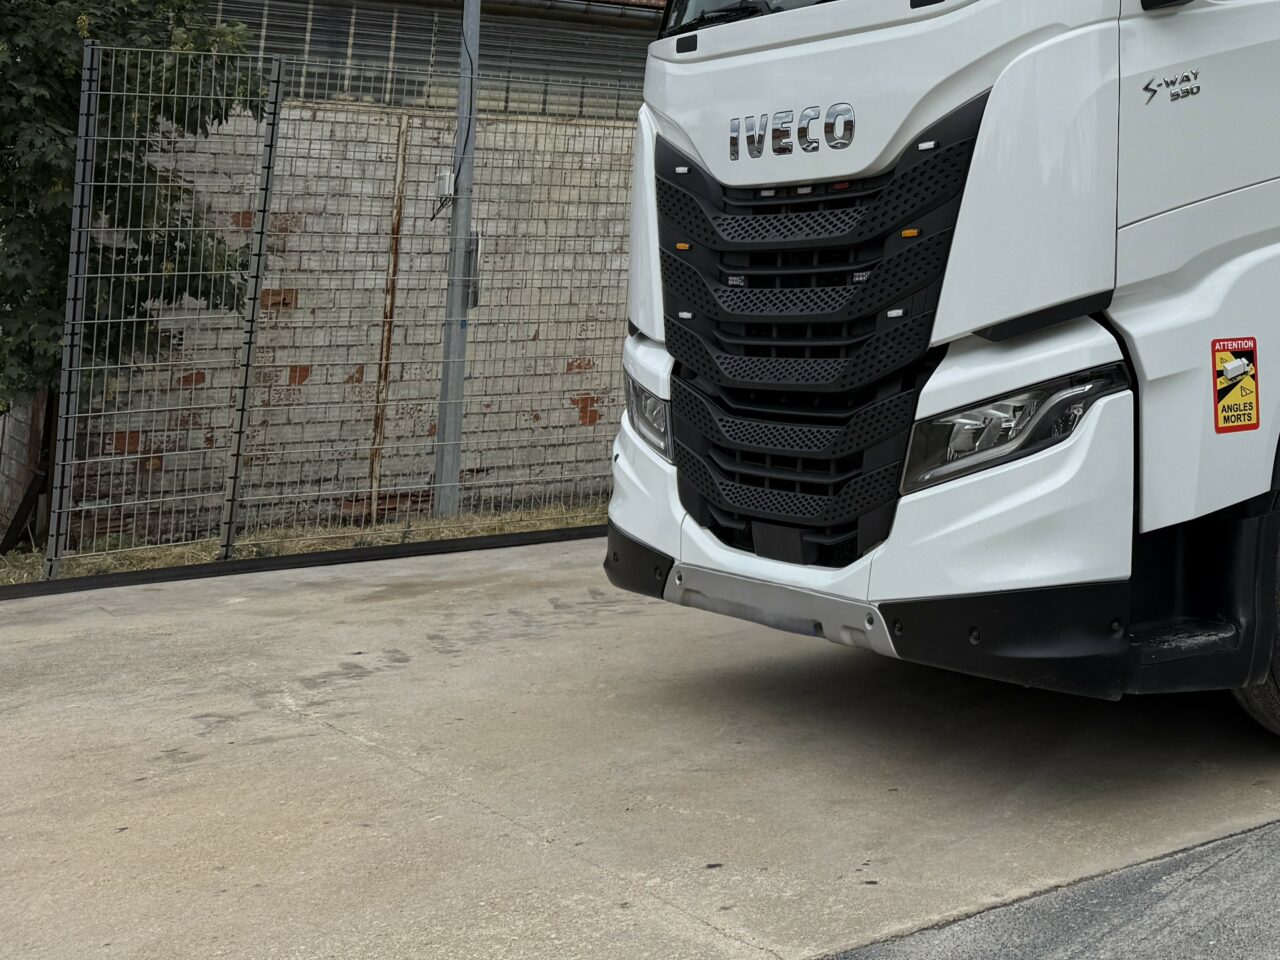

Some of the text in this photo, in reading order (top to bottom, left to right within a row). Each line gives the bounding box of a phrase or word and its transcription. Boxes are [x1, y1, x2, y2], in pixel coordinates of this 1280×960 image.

[1142, 68, 1200, 106] S-WAY
[1170, 84, 1201, 102] 530
[729, 102, 856, 162] IVECO
[1215, 340, 1254, 350] ATTENTION
[1221, 401, 1254, 414] ANGLES
[1223, 412, 1252, 424] MORTS
